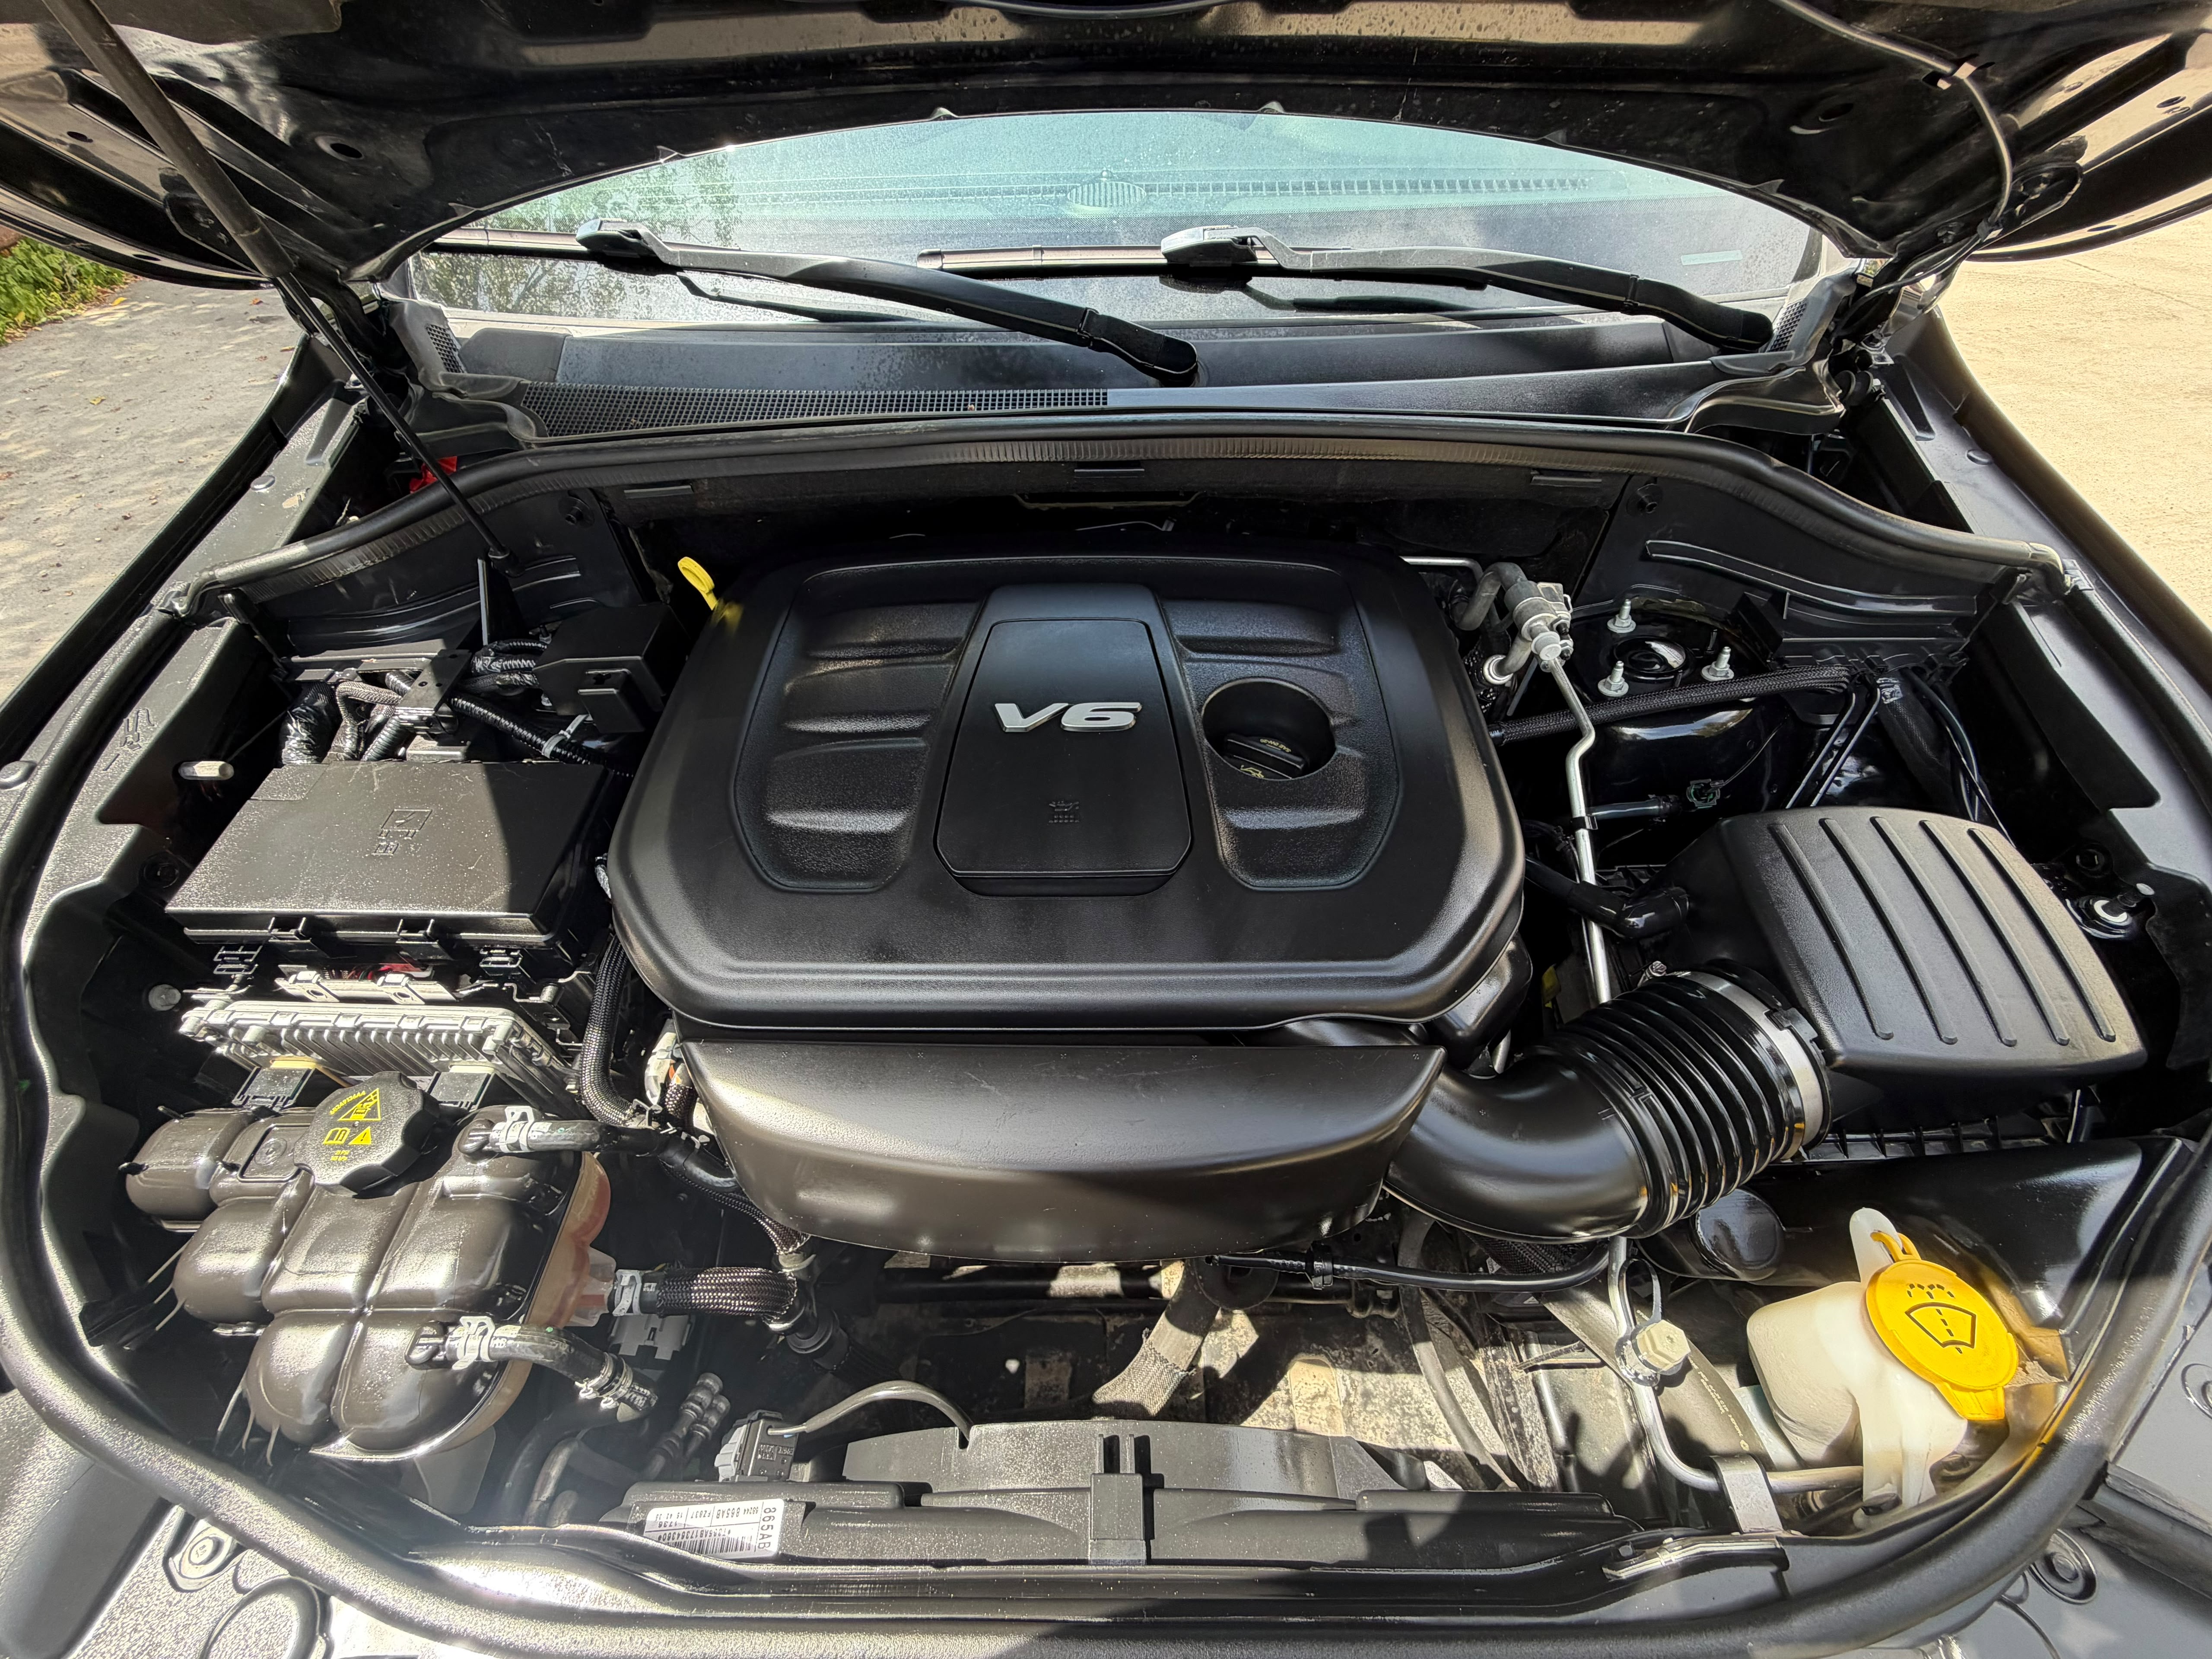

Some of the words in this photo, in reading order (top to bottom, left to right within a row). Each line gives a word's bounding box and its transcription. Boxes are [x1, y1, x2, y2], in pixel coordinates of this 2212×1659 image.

[995, 702, 1142, 733] V6
[1279, 744, 1291, 752] SAE
[716, 1507, 740, 1519] 865AB
[757, 1507, 776, 1549] 865AB
